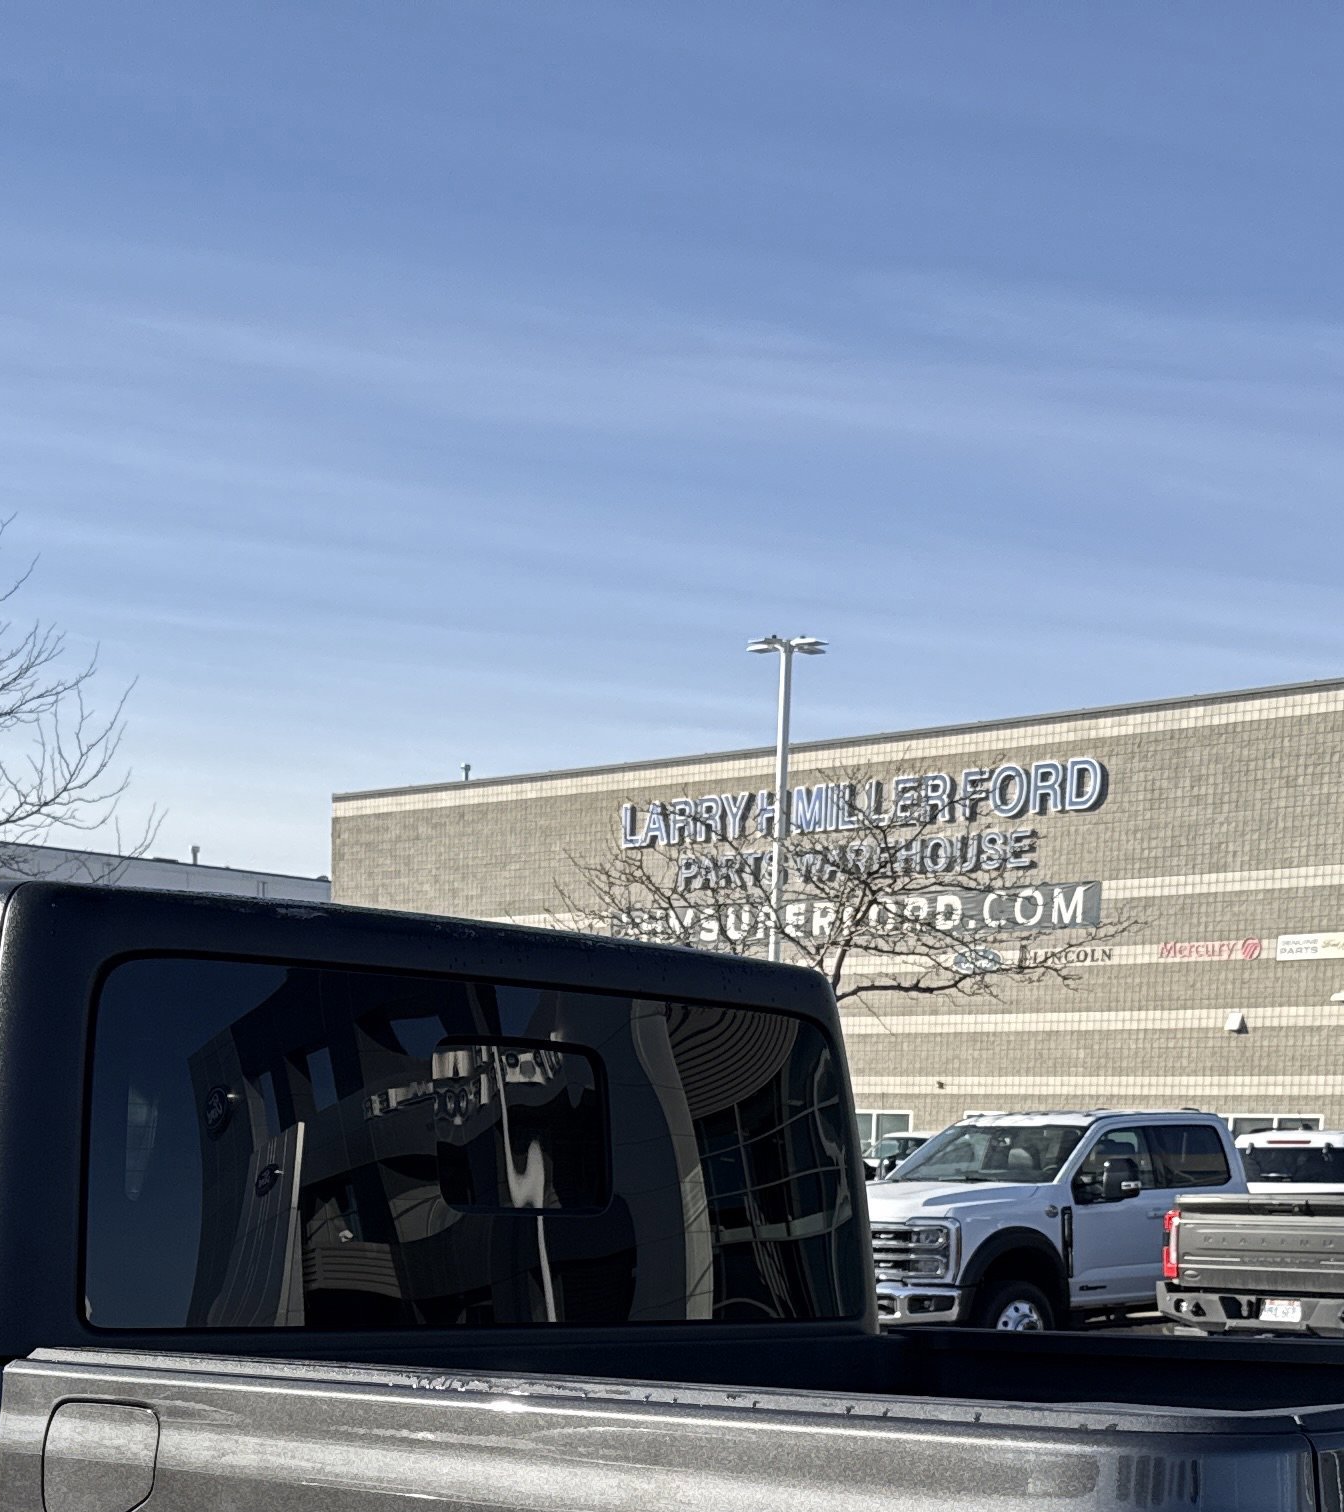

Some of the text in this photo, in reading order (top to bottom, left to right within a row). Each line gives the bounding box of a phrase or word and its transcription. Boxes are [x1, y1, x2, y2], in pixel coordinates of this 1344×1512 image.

[621, 791, 751, 849] LARRY
[792, 774, 953, 835] MILLER
[961, 757, 1105, 820] FORD
[1031, 947, 1114, 966] LINCOLN
[1158, 940, 1238, 959] Mercury
[1279, 946, 1319, 955] PARTS
